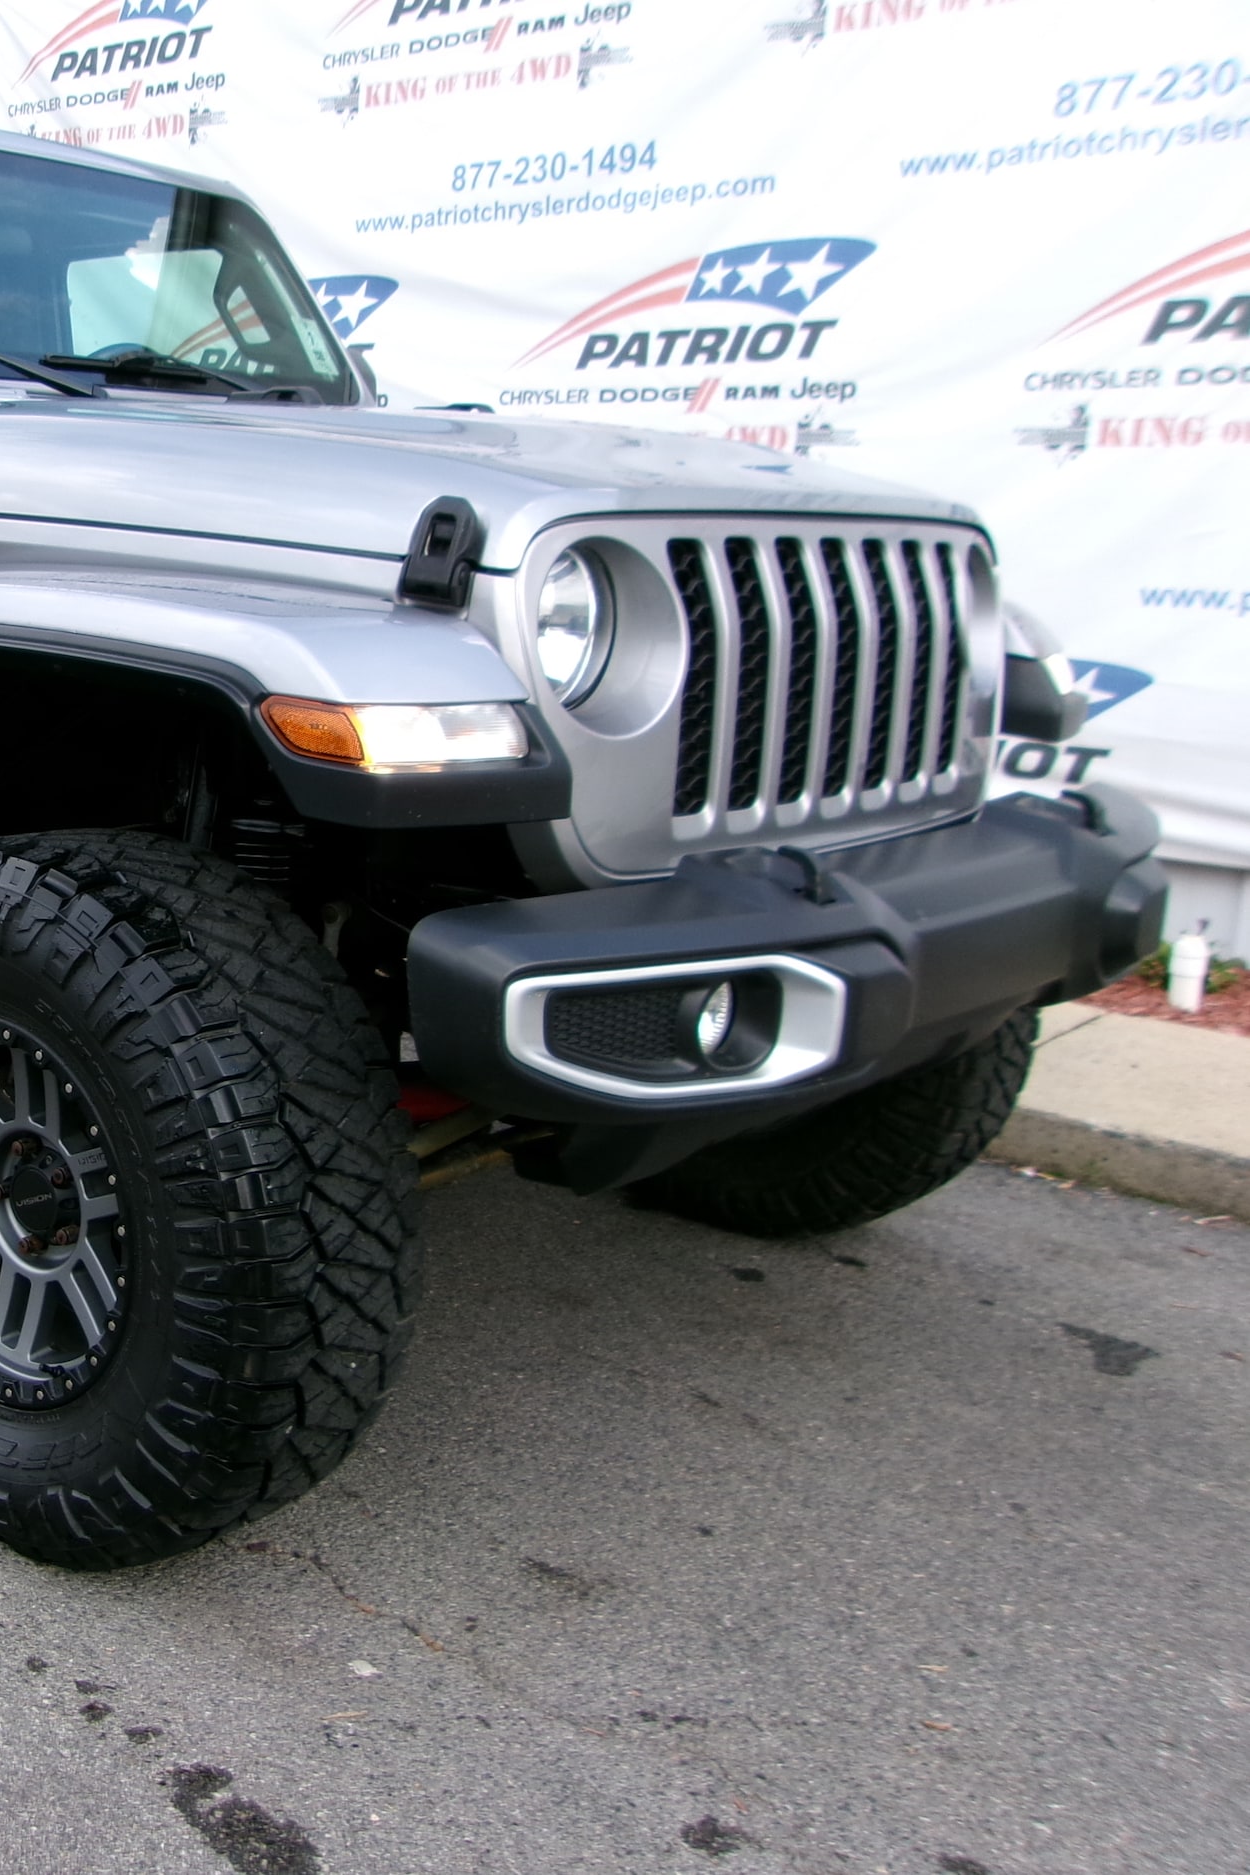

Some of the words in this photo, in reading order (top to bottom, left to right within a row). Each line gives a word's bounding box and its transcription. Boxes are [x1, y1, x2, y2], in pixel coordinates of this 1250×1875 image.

[51, 24, 214, 82] PATRIOT
[322, 43, 400, 70] CHRYSLER
[409, 25, 497, 54] DODGE
[517, 15, 566, 37] RAM
[574, 1, 632, 26] Jeep
[7, 97, 61, 118] CHRYSLER
[66, 87, 131, 108] DODGE
[145, 81, 179, 98] RAM
[185, 72, 226, 93] Jeep
[364, 75, 428, 109] KING
[434, 74, 458, 96] OF
[464, 67, 502, 90] THE
[511, 52, 573, 83] 4WD
[86, 128, 103, 145] OF
[108, 124, 136, 142] THE
[142, 113, 185, 140] 4WD
[451, 139, 658, 193] 877-230-1494
[354, 174, 777, 234] www.patriotchryslerdodgejeep.com
[575, 319, 840, 370] PATRIOT
[498, 389, 590, 407] CHRYSLER
[599, 386, 700, 404] DODGE
[724, 385, 781, 402] RAM
[790, 376, 857, 404] Jeep
[1023, 368, 1161, 392] CHRYSLER
[1097, 414, 1209, 448] KING
[15, 1191, 53, 1208] VISION
